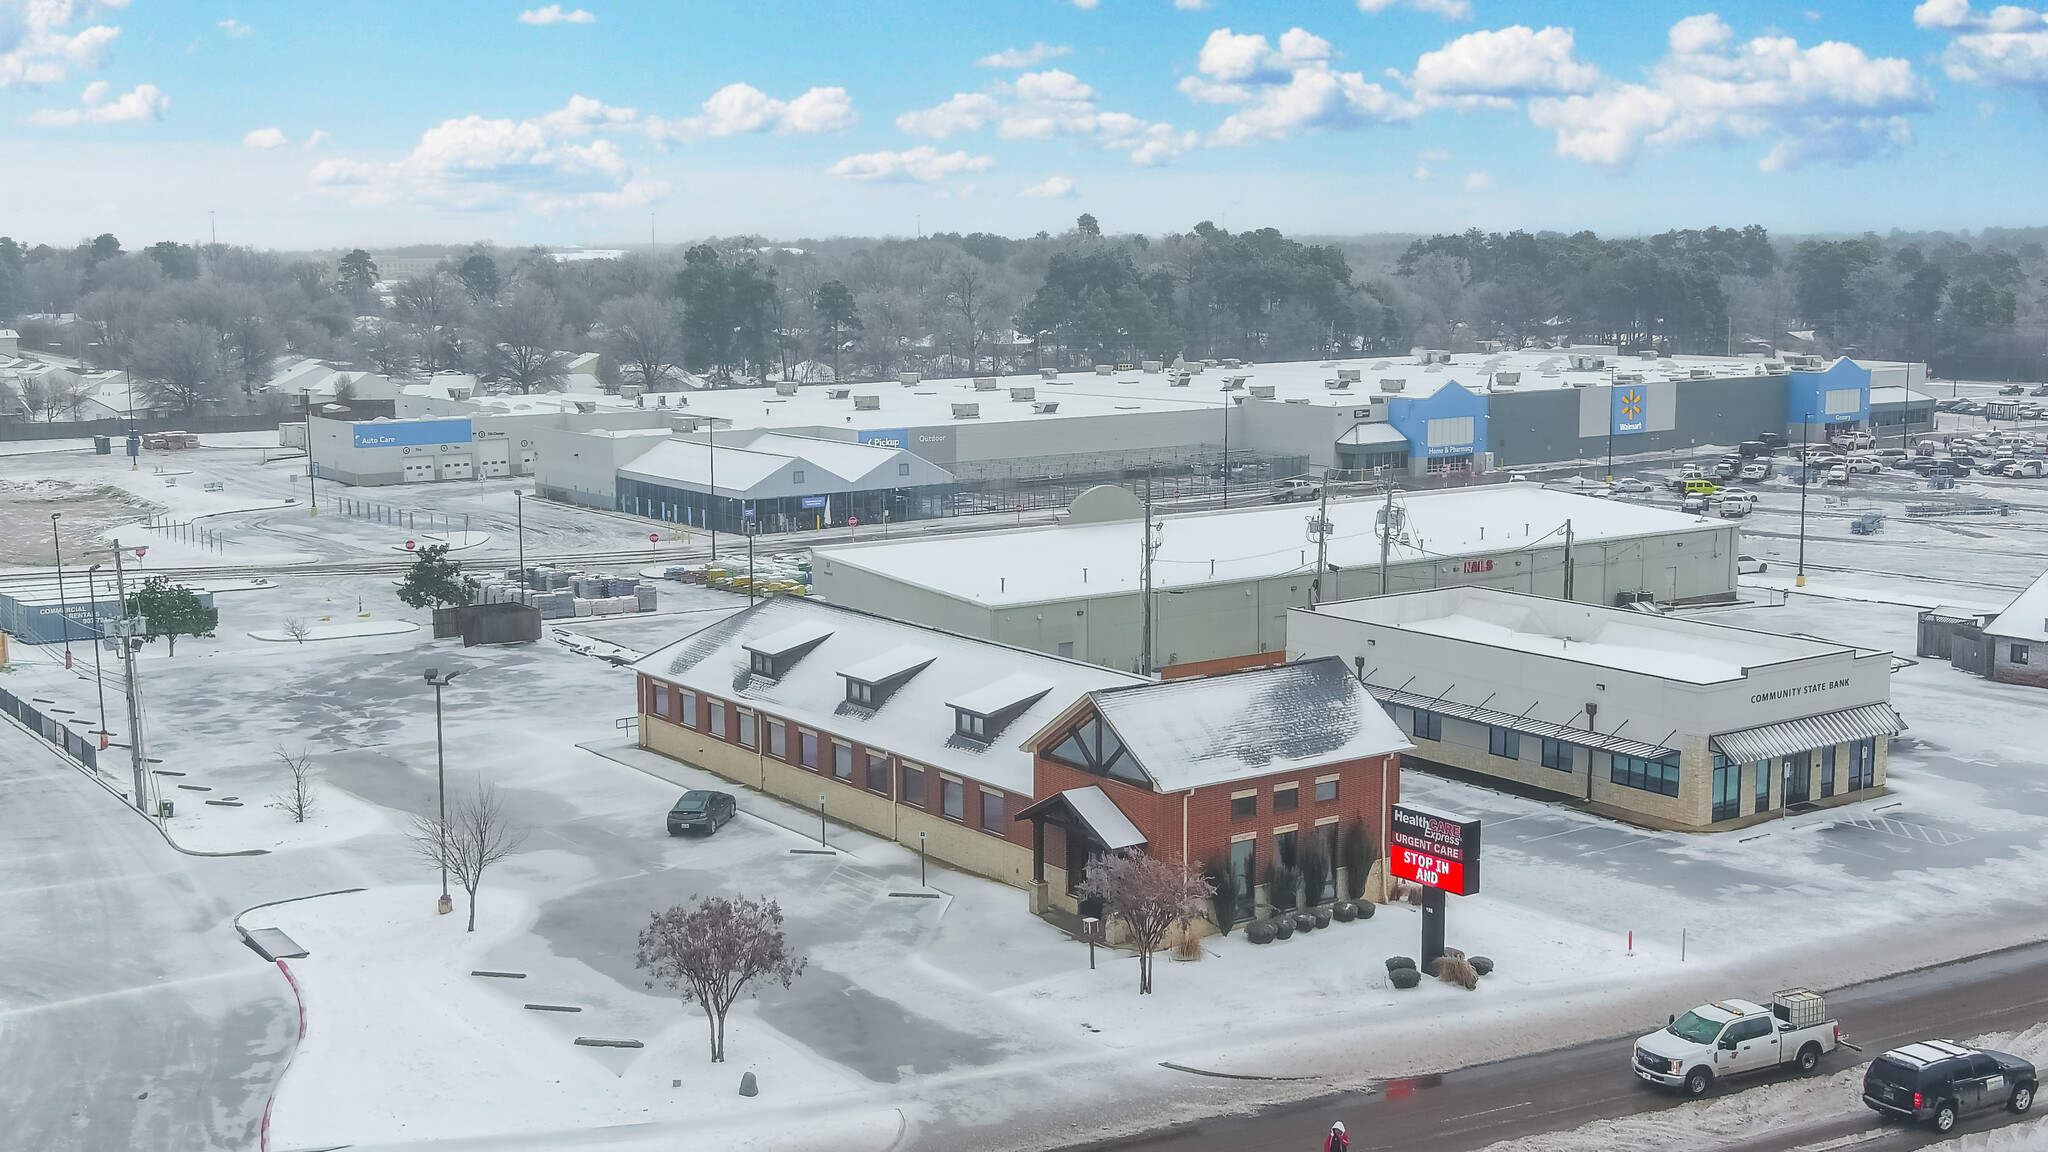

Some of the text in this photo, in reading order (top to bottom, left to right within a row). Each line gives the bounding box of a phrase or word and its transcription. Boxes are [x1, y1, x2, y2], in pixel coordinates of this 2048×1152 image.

[1619, 422, 1642, 431] Walmart
[361, 435, 396, 445] Auto Care
[874, 437, 900, 448] Pickup
[1428, 447, 1443, 455] Home
[1449, 445, 1474, 453] Pharmacy
[1464, 560, 1493, 573] NAILS
[40, 606, 86, 614] COMMRCIAL
[1751, 678, 1850, 703] COMMUNITY STATE BANK
[1424, 827, 1460, 846] Express
[1395, 832, 1459, 858] URGENT CARE
[1404, 850, 1449, 874] STOP IN
[1416, 867, 1438, 884] AND
